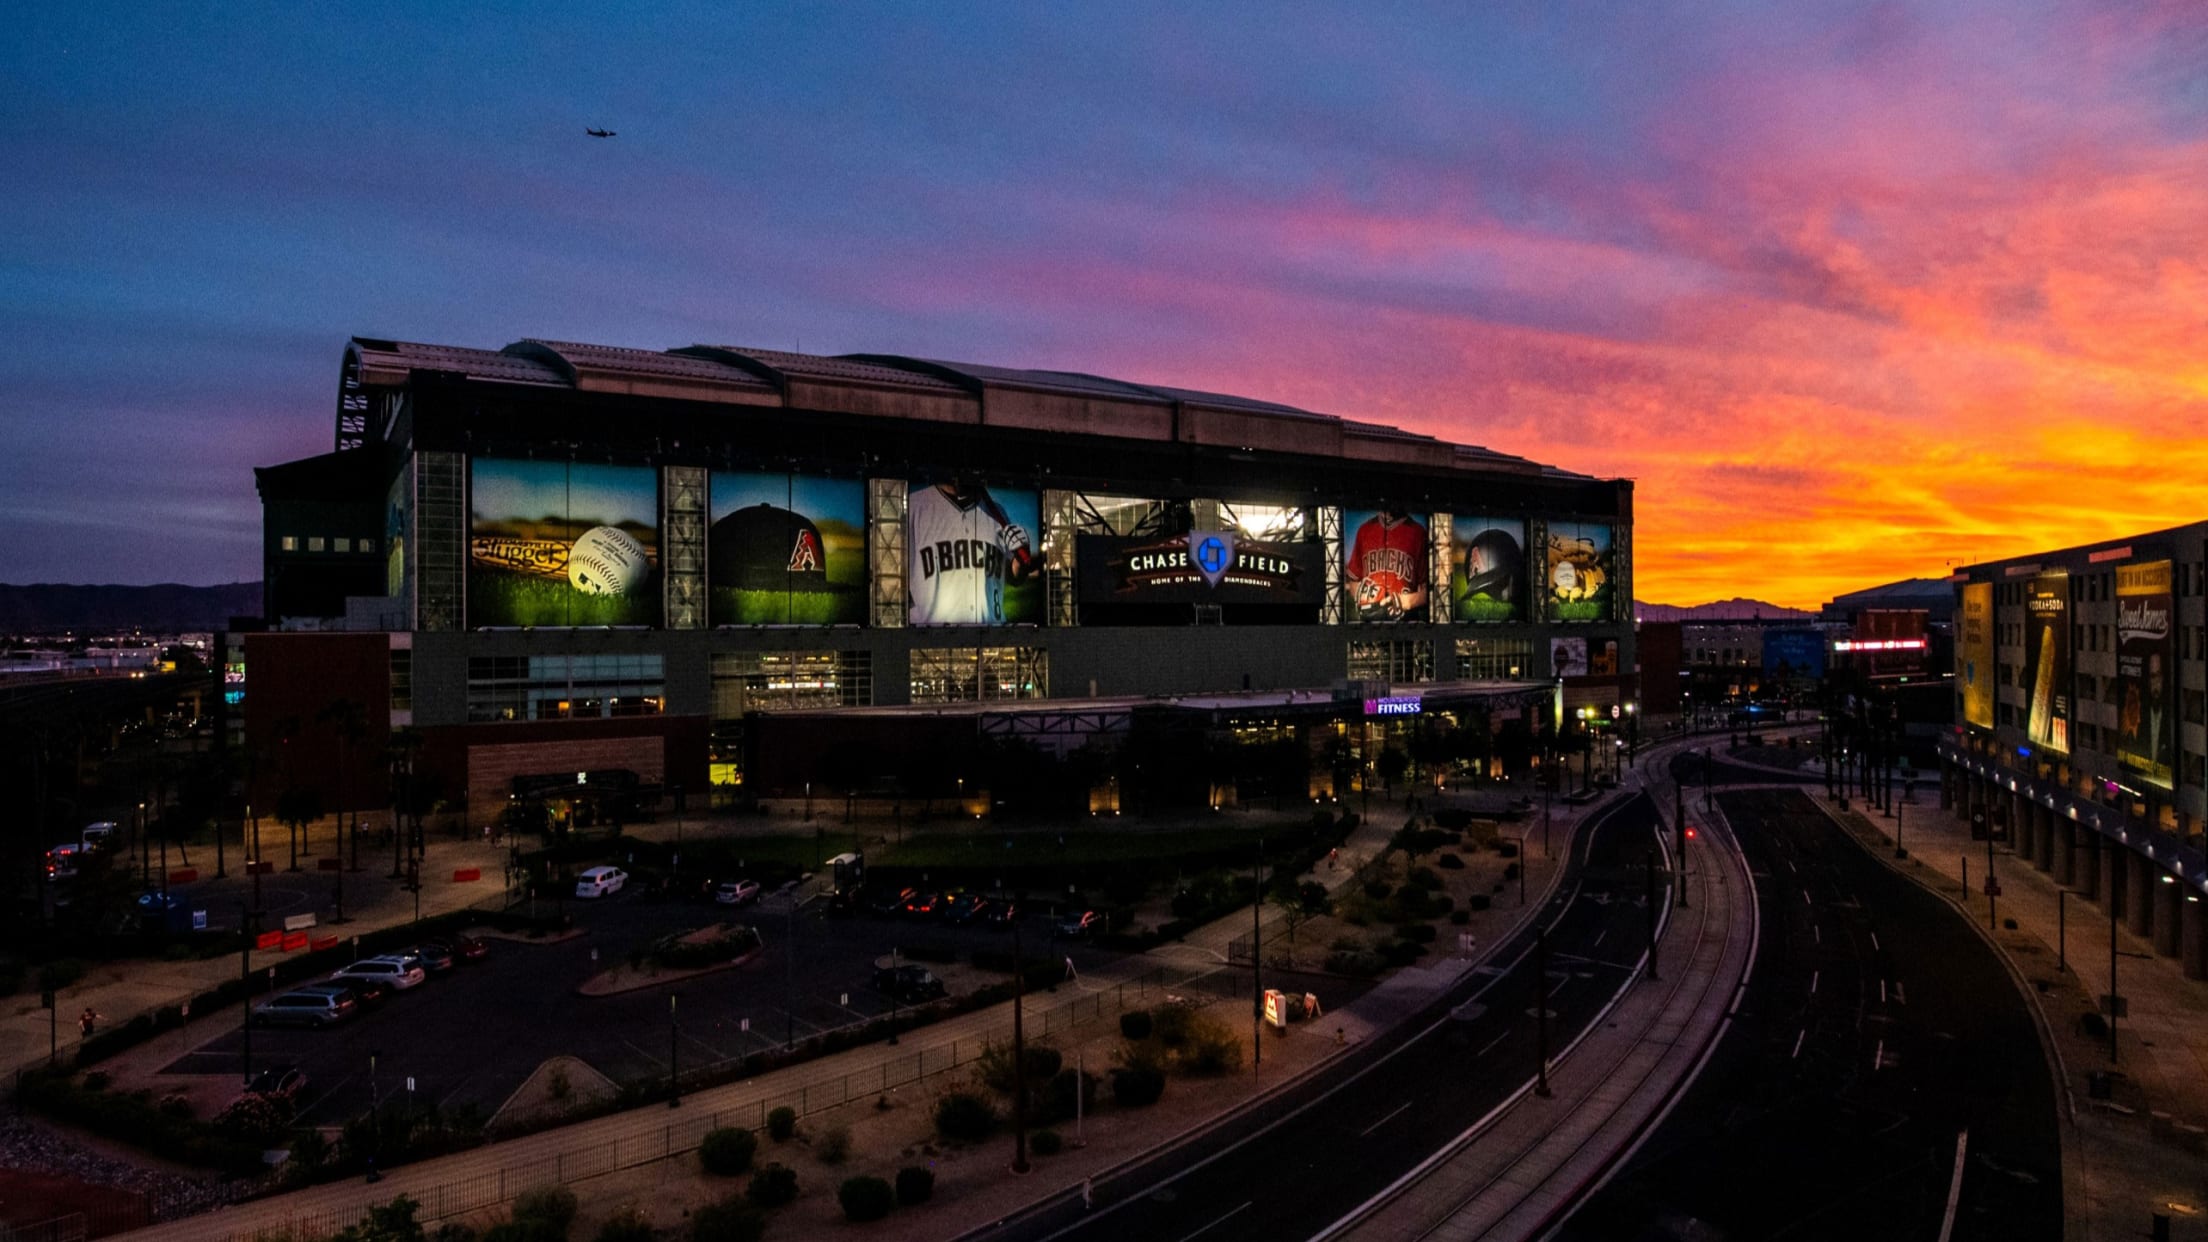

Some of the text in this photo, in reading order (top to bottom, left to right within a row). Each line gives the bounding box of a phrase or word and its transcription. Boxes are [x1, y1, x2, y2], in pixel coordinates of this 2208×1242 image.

[473, 538, 562, 567] Slugger
[1130, 552, 1289, 575] CHASE FIELD
[1151, 577, 1171, 585] HOME
[1224, 576, 1272, 588] DIAMONDBACKS
[993, 589, 1003, 621] 8
[1377, 703, 1421, 714] FITNESS
